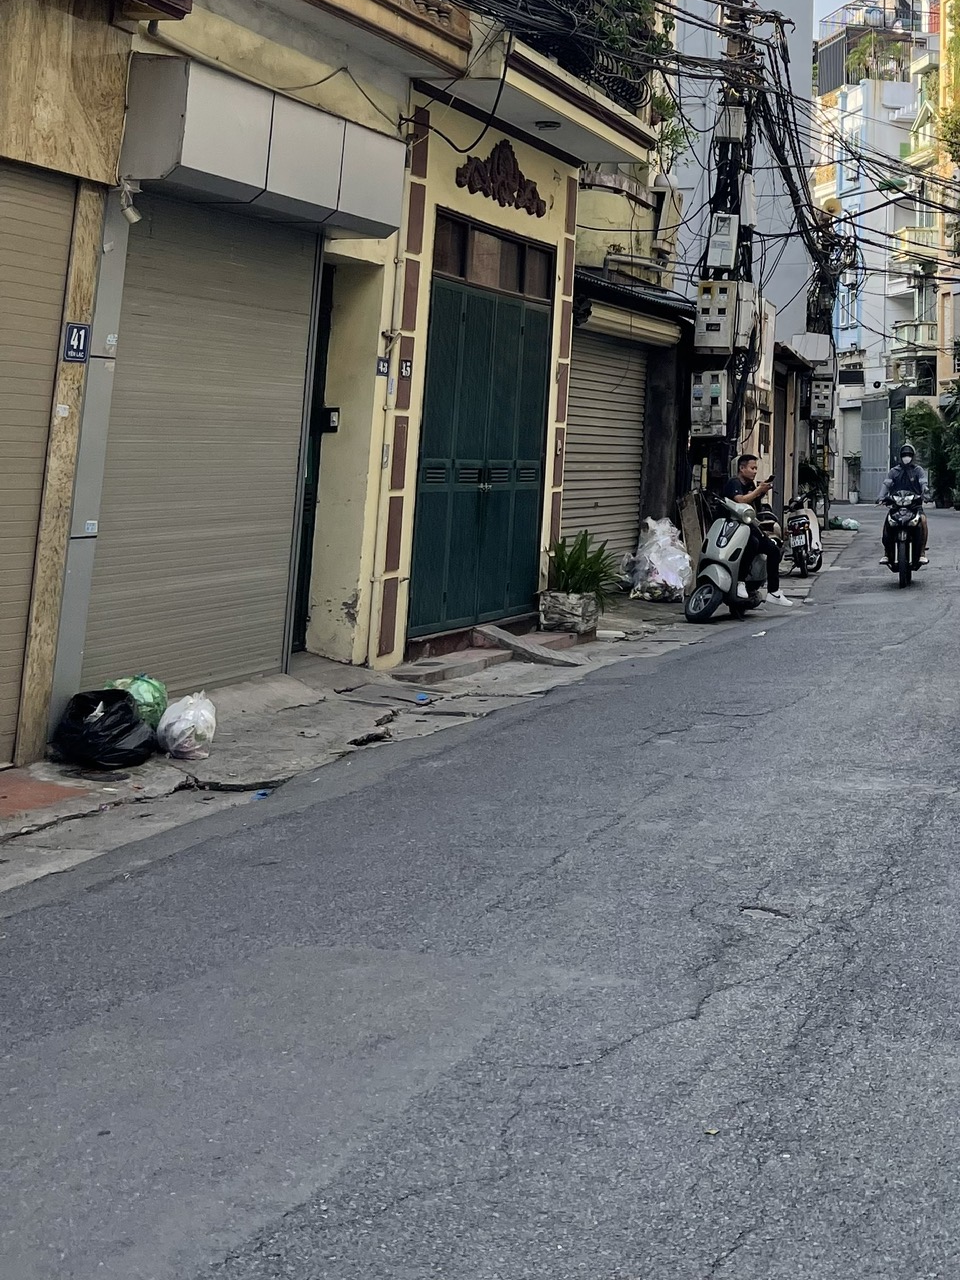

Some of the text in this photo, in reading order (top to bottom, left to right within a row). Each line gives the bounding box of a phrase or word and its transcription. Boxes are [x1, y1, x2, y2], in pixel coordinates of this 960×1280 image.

[70, 328, 85, 350] 41
[378, 360, 388, 373] 43
[401, 361, 411, 377] 45
